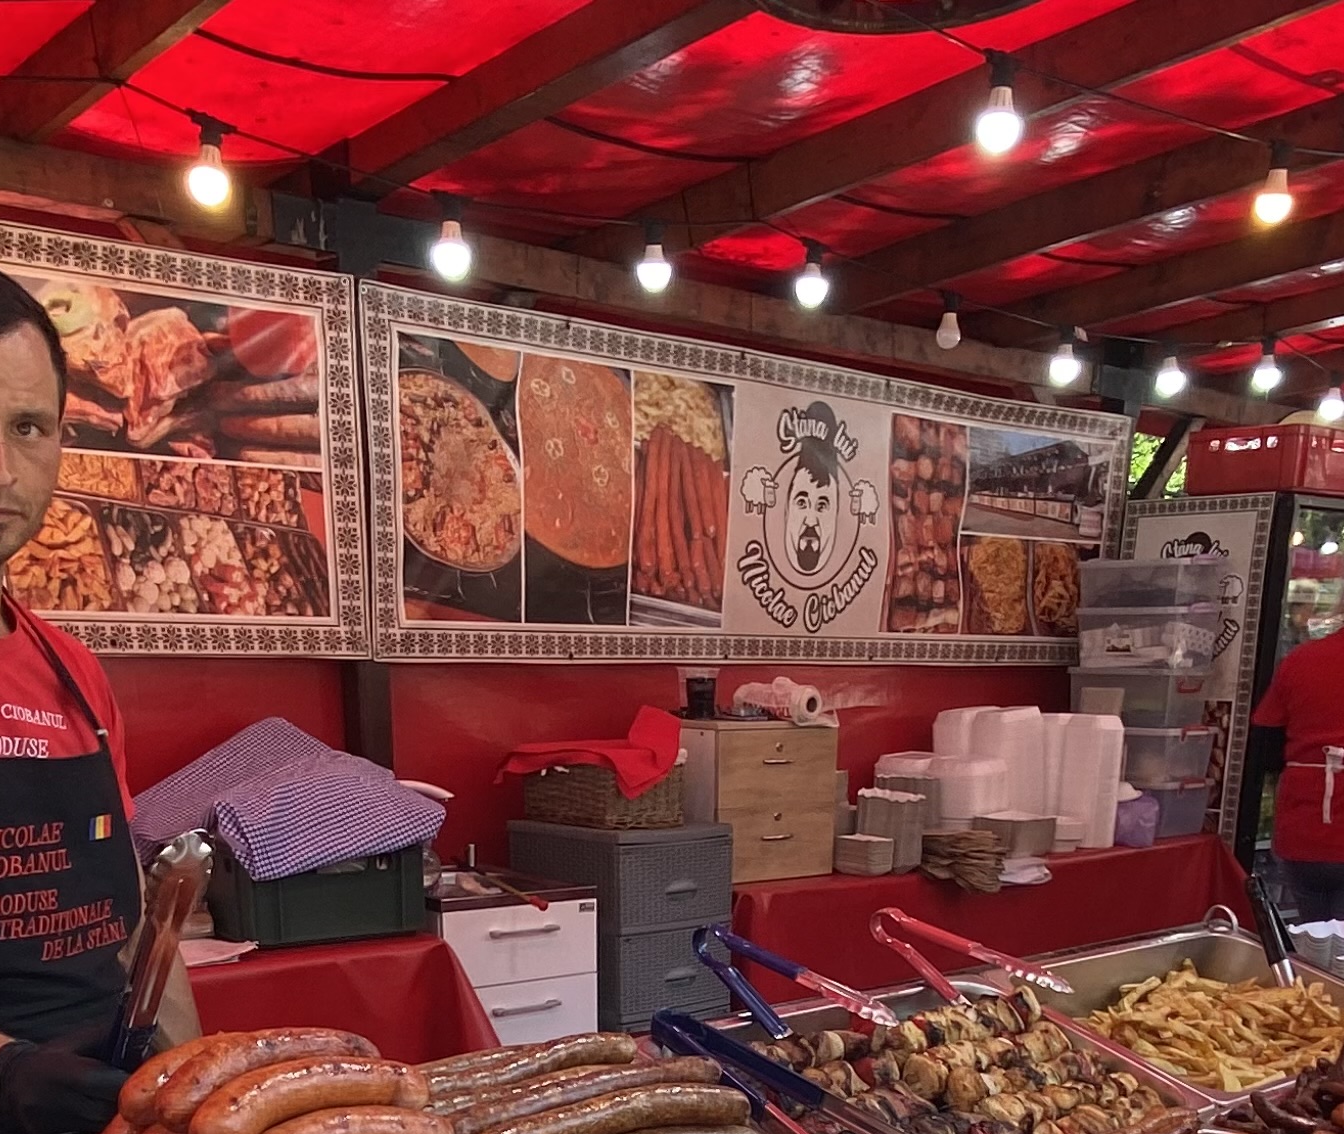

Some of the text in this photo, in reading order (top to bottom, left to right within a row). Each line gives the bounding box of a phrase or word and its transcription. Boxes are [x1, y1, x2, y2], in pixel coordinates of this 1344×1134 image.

[777, 406, 858, 461] Stâna lui
[737, 540, 877, 633] Nicolae Ciobanul
[1, 703, 67, 729] CIOBANUL
[41, 941, 64, 962] DE
[66, 934, 85, 957] LA
